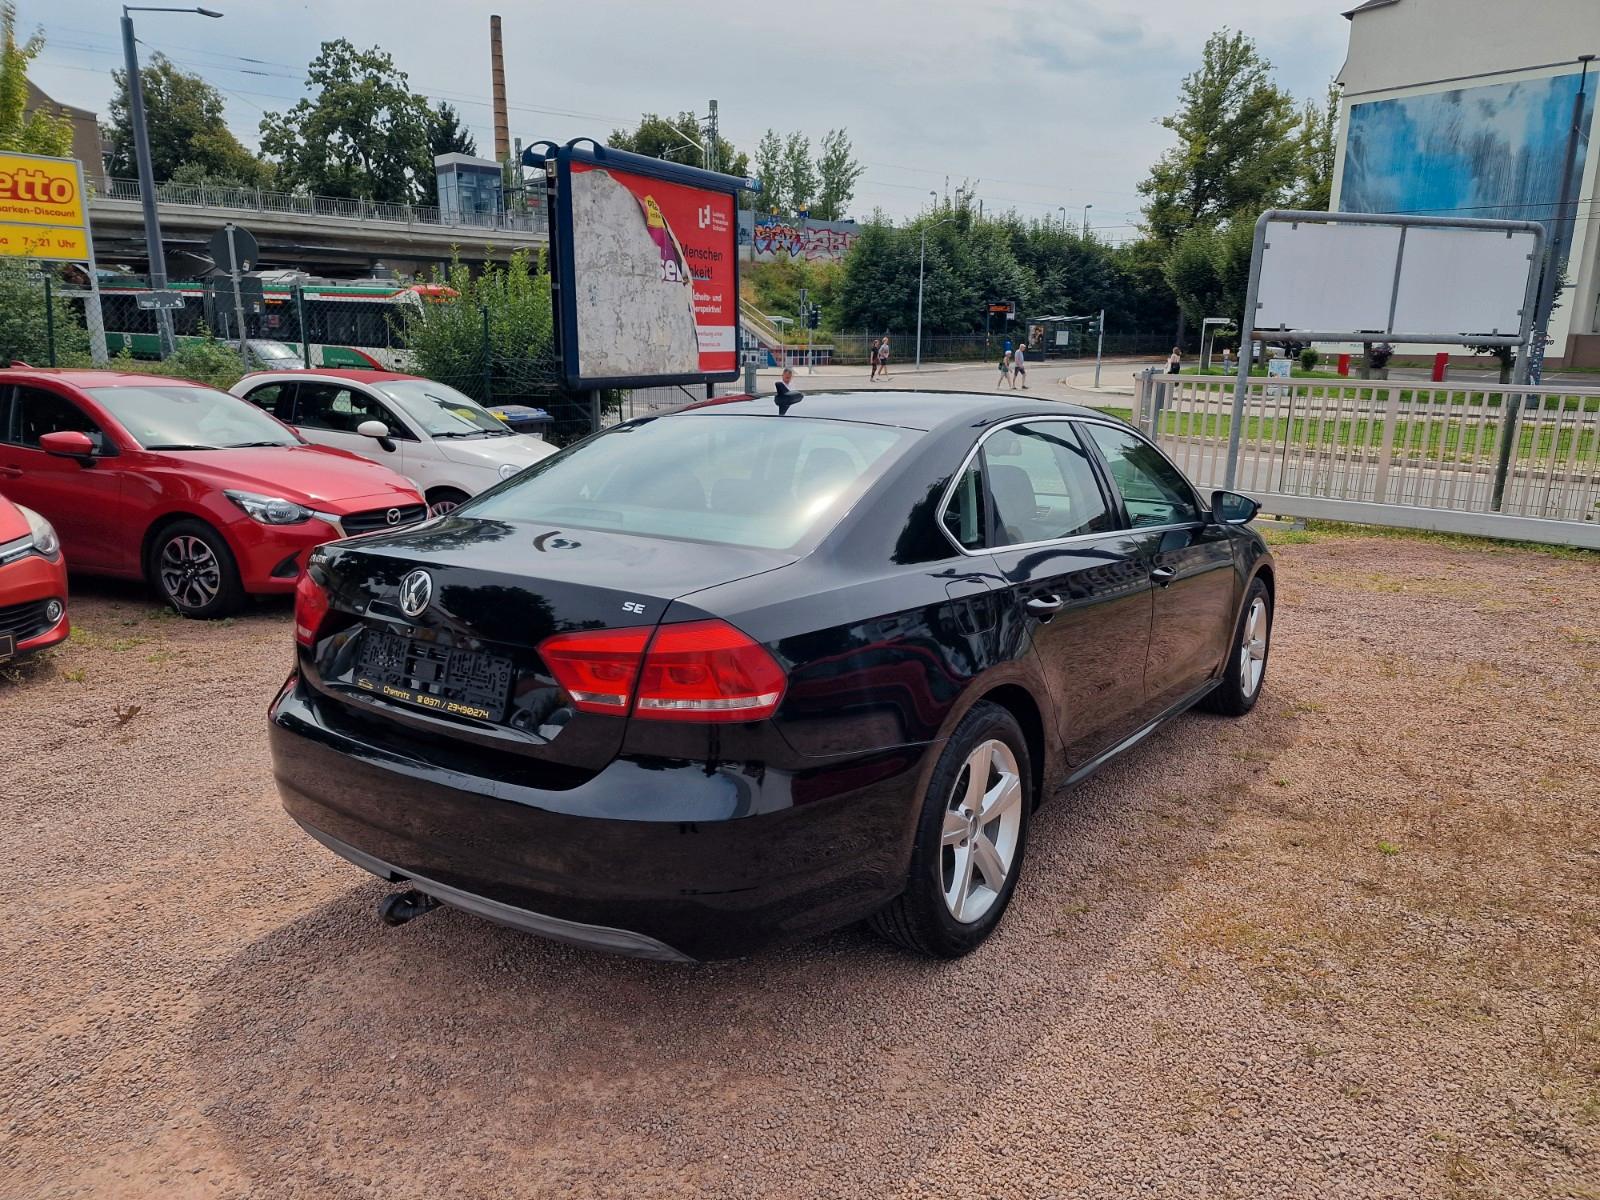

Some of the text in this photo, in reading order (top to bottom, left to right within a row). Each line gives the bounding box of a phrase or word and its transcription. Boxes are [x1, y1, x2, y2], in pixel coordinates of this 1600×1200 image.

[57, 239, 76, 248] Uhr
[712, 293, 722, 302] und
[621, 601, 646, 615] SE
[383, 685, 410, 700] Chemnitz
[423, 696, 440, 707] 0371
[447, 702, 489, 719] 23490274
